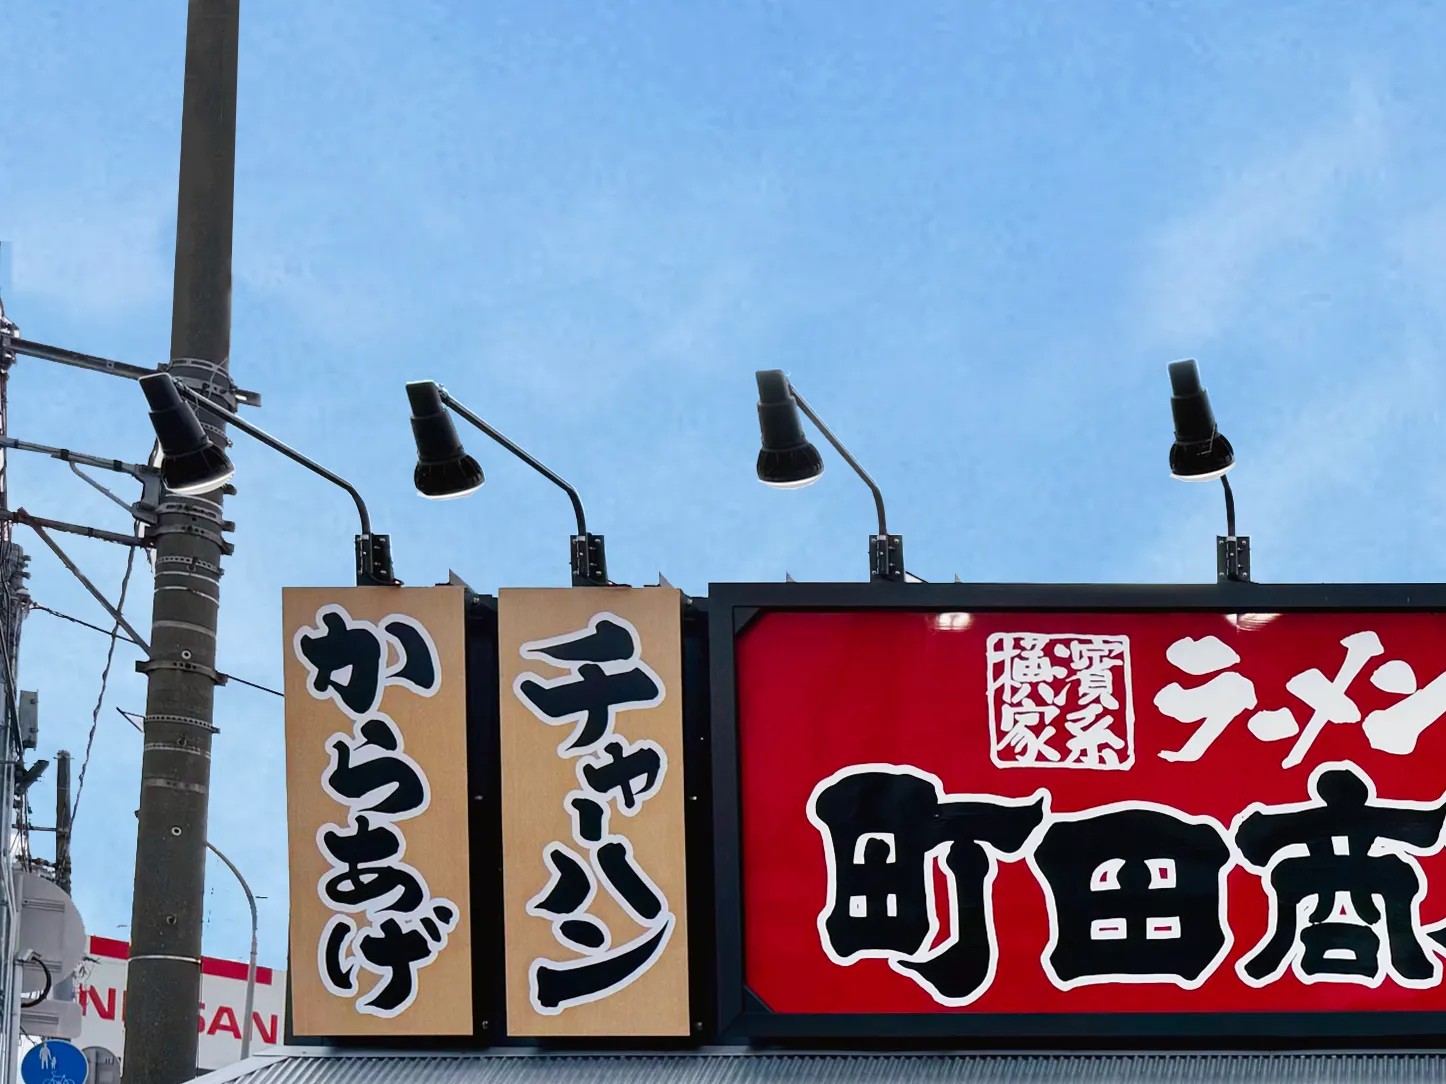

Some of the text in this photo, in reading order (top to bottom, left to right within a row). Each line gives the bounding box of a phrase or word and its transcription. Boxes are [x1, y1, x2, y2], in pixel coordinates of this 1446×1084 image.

[294, 604, 459, 1017] からあげ
[512, 612, 677, 1016] チャーハン
